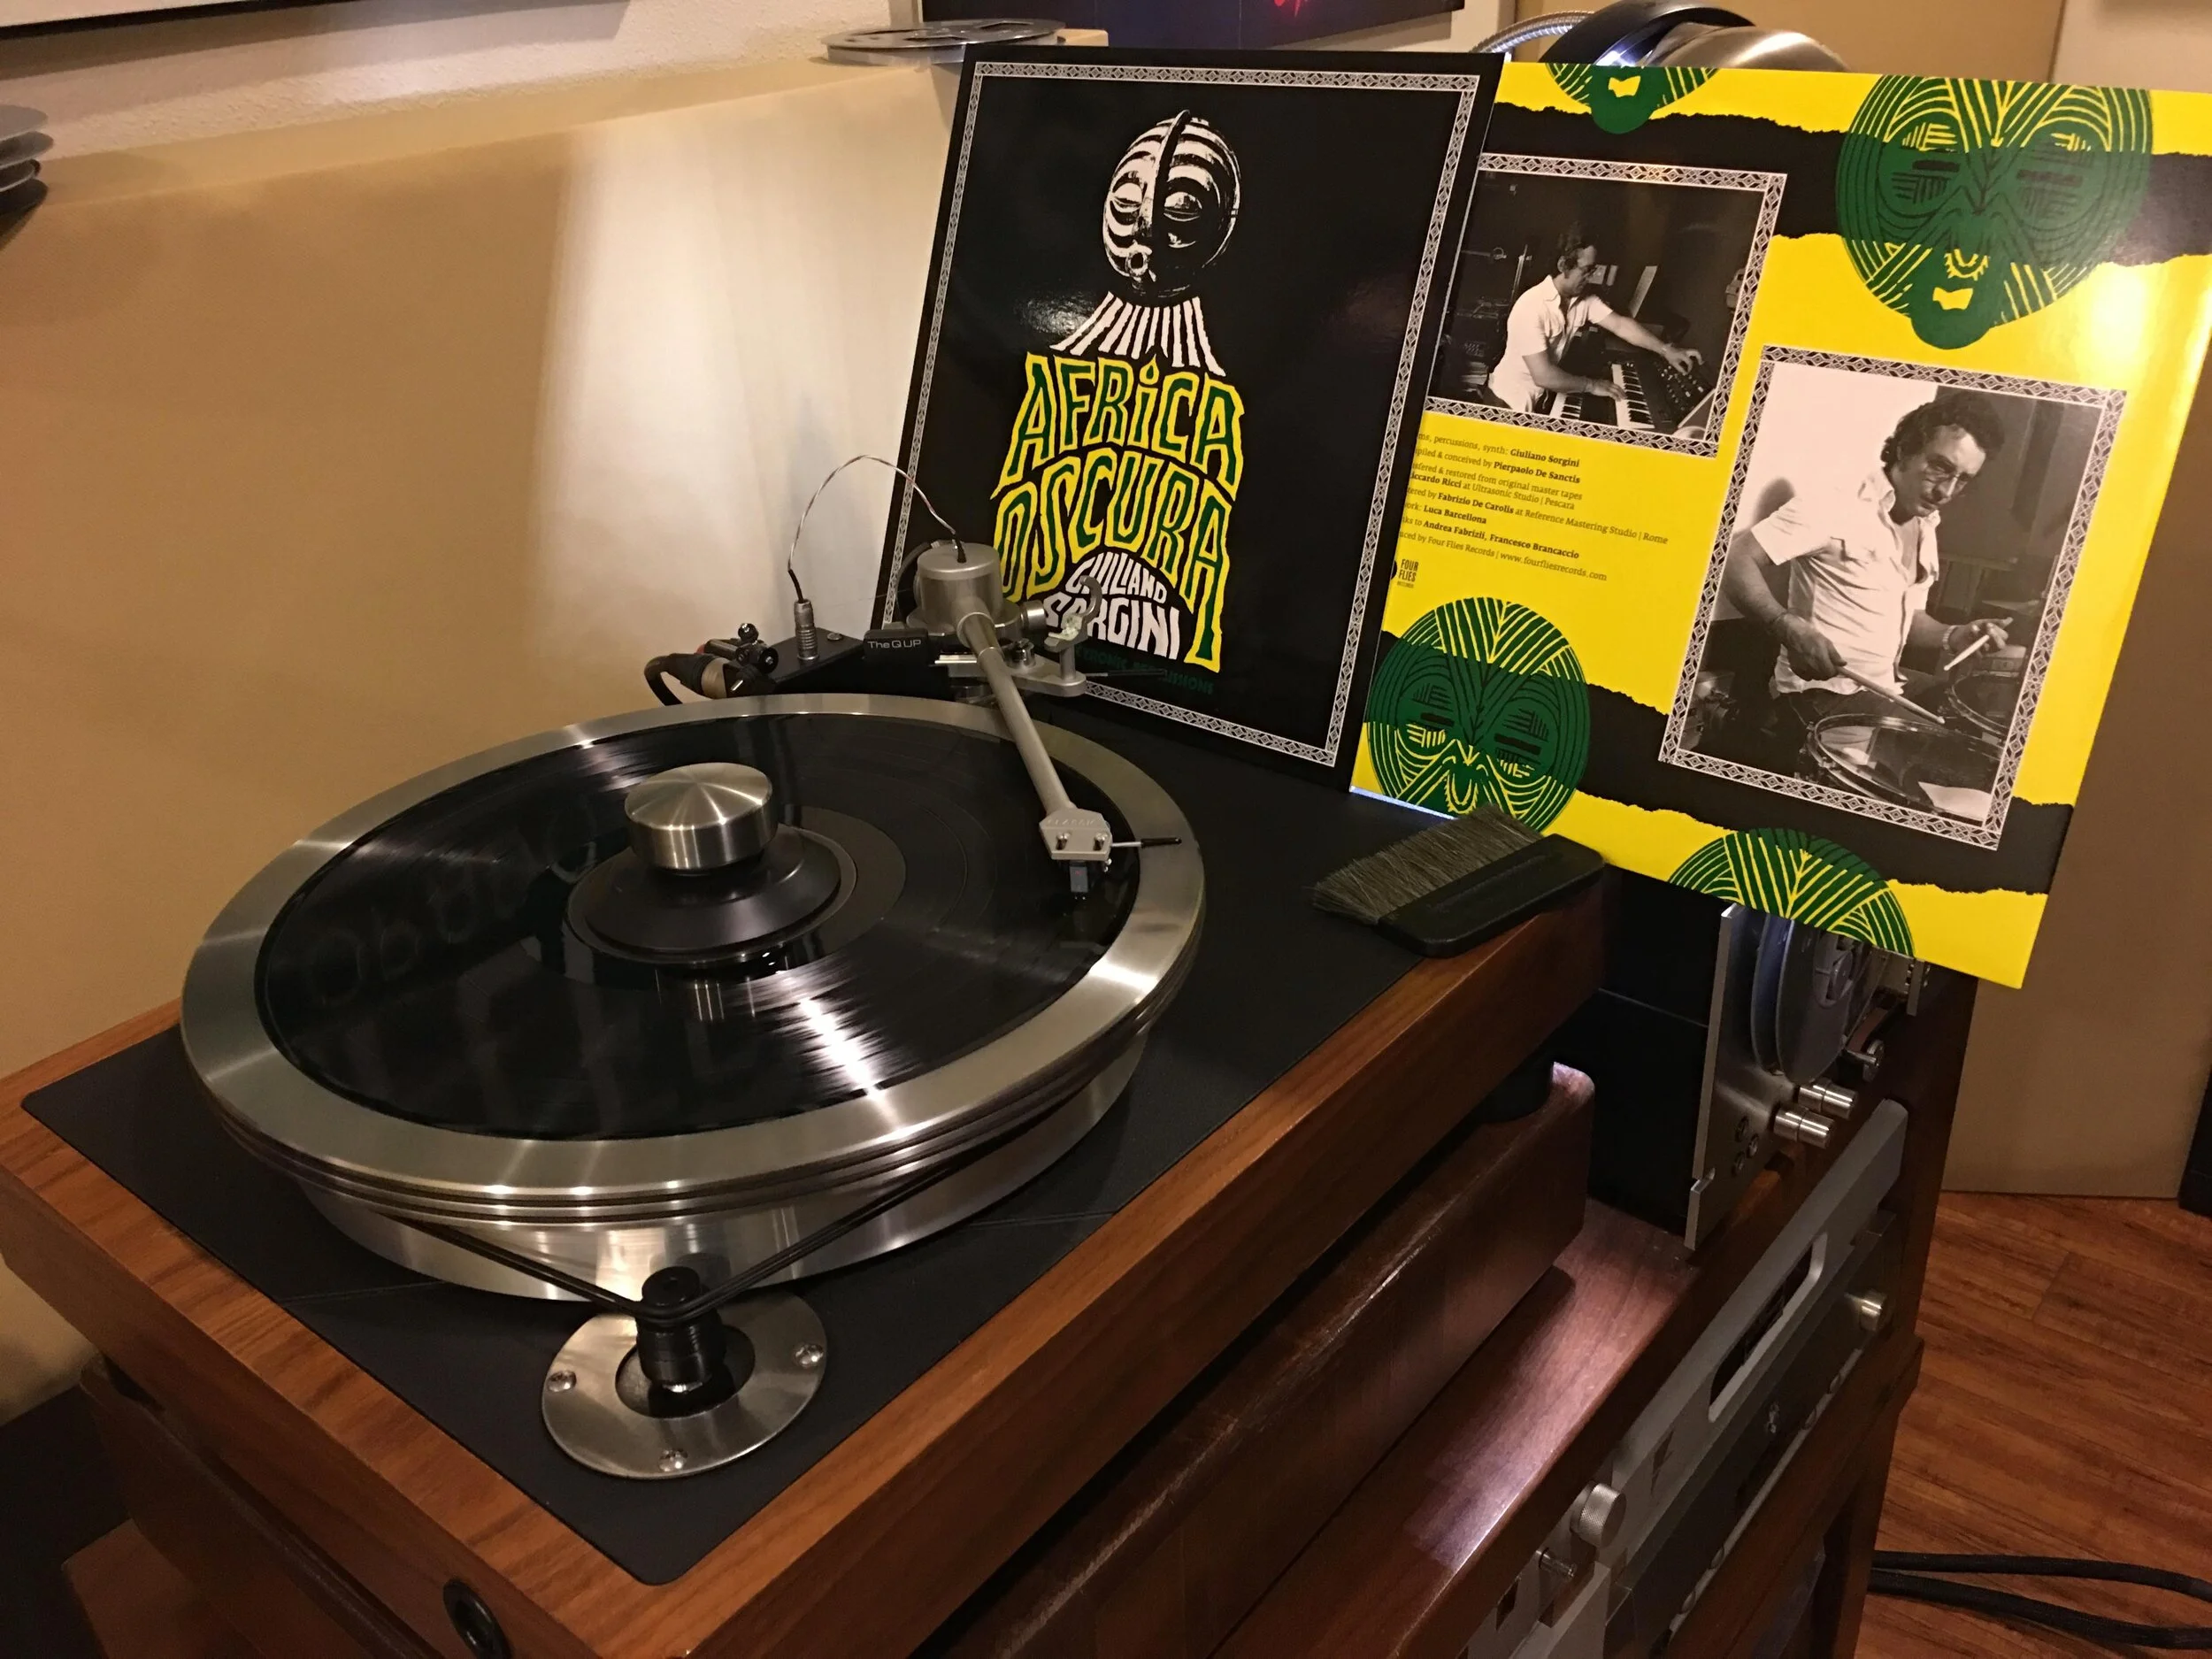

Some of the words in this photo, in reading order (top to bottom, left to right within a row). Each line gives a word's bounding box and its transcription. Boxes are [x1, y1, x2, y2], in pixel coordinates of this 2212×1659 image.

[1416, 448, 1436, 457] piled
[1444, 453, 1481, 465] conceived
[1483, 459, 1493, 469] by
[1494, 461, 1534, 474] Pierpaolo
[1535, 469, 1548, 478] De
[1548, 471, 1581, 484] Sanctis
[1417, 433, 1432, 442] ms,
[1433, 436, 1480, 450] percussions,
[1509, 449, 1547, 461] Giuliano
[1548, 455, 1580, 467] Sorgini
[1441, 478, 1462, 488] Ricci
[1471, 482, 1512, 497] Ultrasonic
[1513, 490, 1540, 503] Studio
[1544, 496, 1575, 511] Pescara
[1446, 468, 1477, 480] restored
[1478, 473, 1497, 485] from
[1498, 479, 1530, 491] original
[1531, 484, 1560, 496] master
[1560, 489, 1584, 501] tapes
[1423, 504, 1442, 515] Luca
[1444, 509, 1487, 525] Barcellona
[1427, 489, 1437, 500] by
[1438, 492, 1471, 505] Fabrizio
[1471, 499, 1484, 508] De
[1485, 502, 1514, 514] Carolis
[1525, 509, 1564, 525] Reference
[1565, 517, 1608, 534] Mastering
[1609, 526, 1638, 539] Studio
[1642, 532, 1668, 545] Rome
[1414, 518, 1423, 526] to
[1423, 520, 1452, 533] Andrea
[1489, 534, 1531, 549] Francesco
[1532, 542, 1579, 559] Brancaccio
[994, 446, 1232, 672] OSCURA
[1400, 558, 1419, 572] FOUR
[1417, 534, 1427, 543] by
[1427, 535, 1446, 547] Four
[1446, 540, 1464, 551] Flies
[1465, 544, 1495, 557] Records
[1500, 552, 1608, 582] www.fourfliesrecords.com
[1397, 569, 1417, 582] FLIES
[866, 640, 891, 649] The
